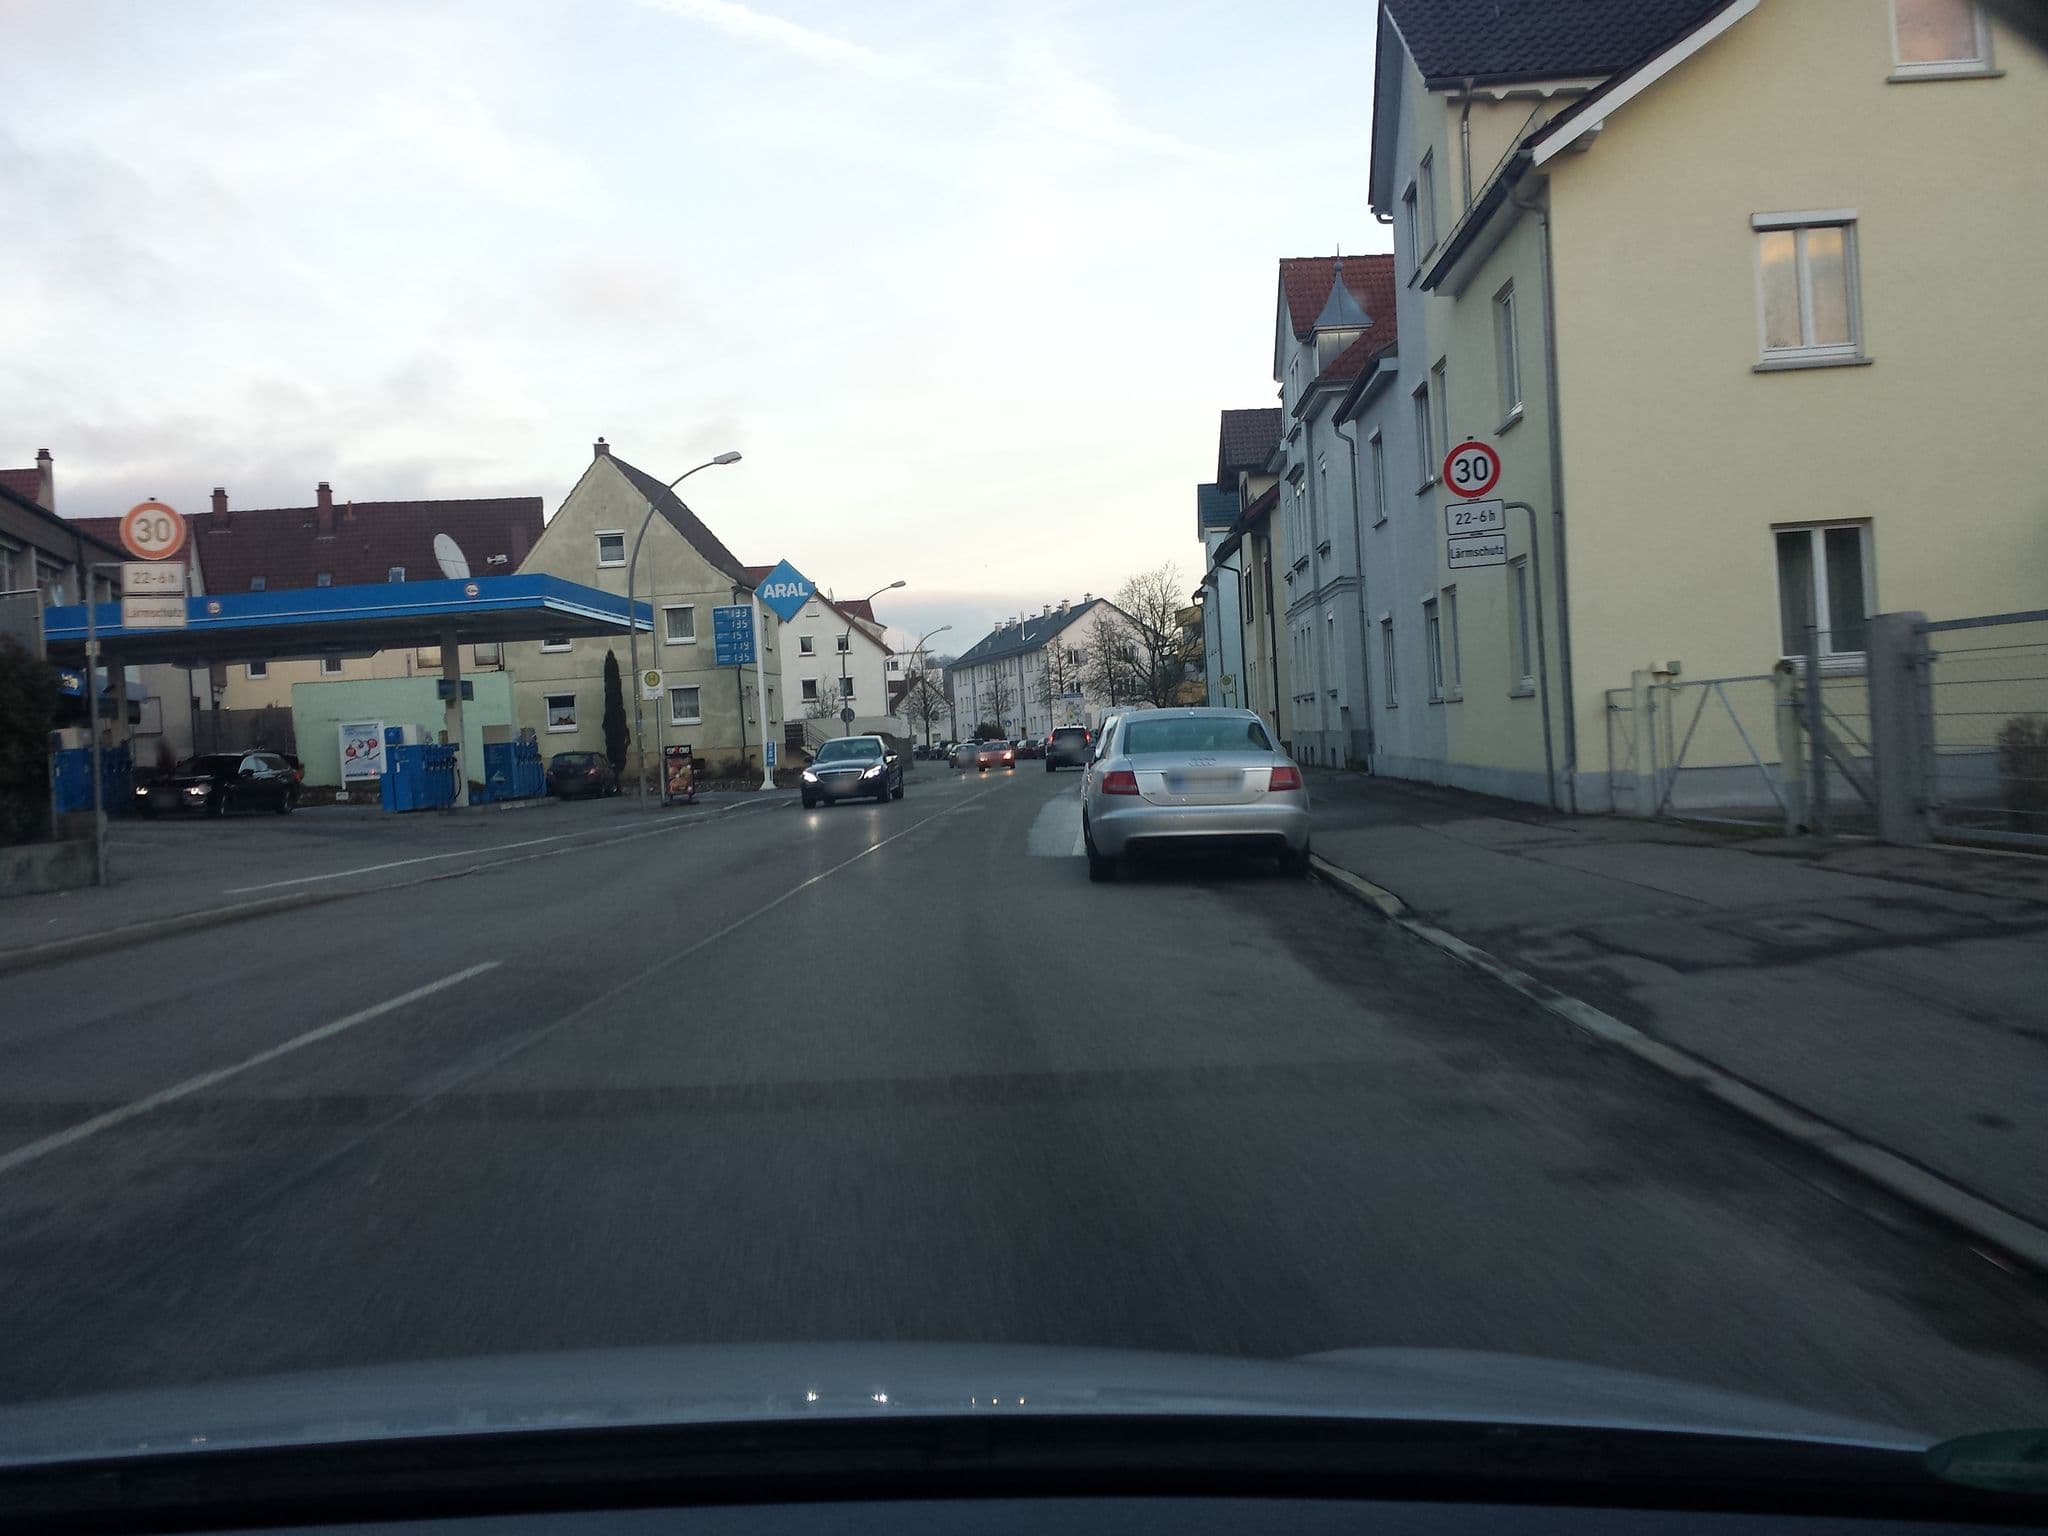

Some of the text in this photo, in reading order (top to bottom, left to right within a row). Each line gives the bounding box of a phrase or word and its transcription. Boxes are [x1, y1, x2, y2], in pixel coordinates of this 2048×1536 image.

[1455, 456, 1488, 484] 30
[135, 518, 170, 543] 30
[1450, 545, 1505, 559] Lärmschutz
[763, 582, 809, 599] ARAL
